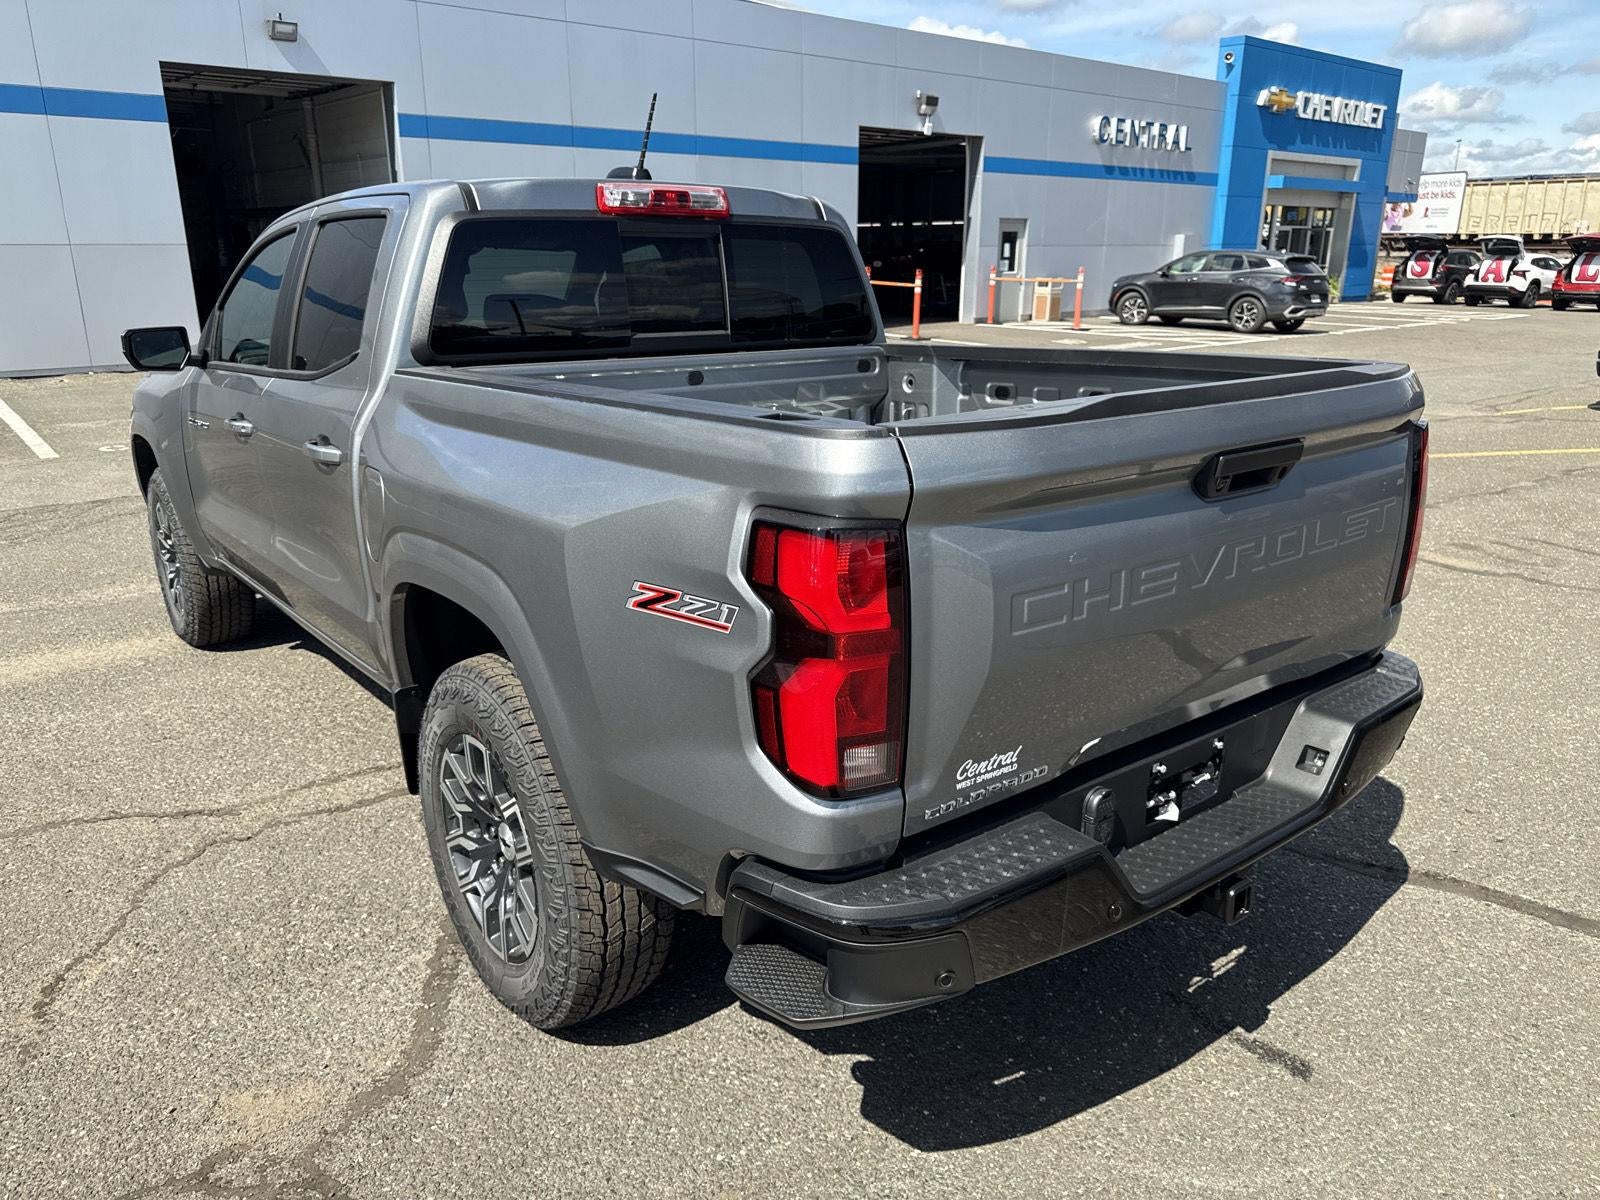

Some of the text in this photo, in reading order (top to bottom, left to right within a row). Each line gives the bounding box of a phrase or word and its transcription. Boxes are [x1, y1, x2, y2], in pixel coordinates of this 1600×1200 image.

[1296, 91, 1387, 129] CHEVROLET
[1096, 115, 1192, 152] CENTRAL
[1010, 497, 1397, 637] CHEVROLET
[625, 579, 740, 634] Z71
[956, 763, 1018, 790] WEST SPRINGFIELD
[957, 745, 1023, 780] Central
[924, 765, 1049, 821] COLORADO
